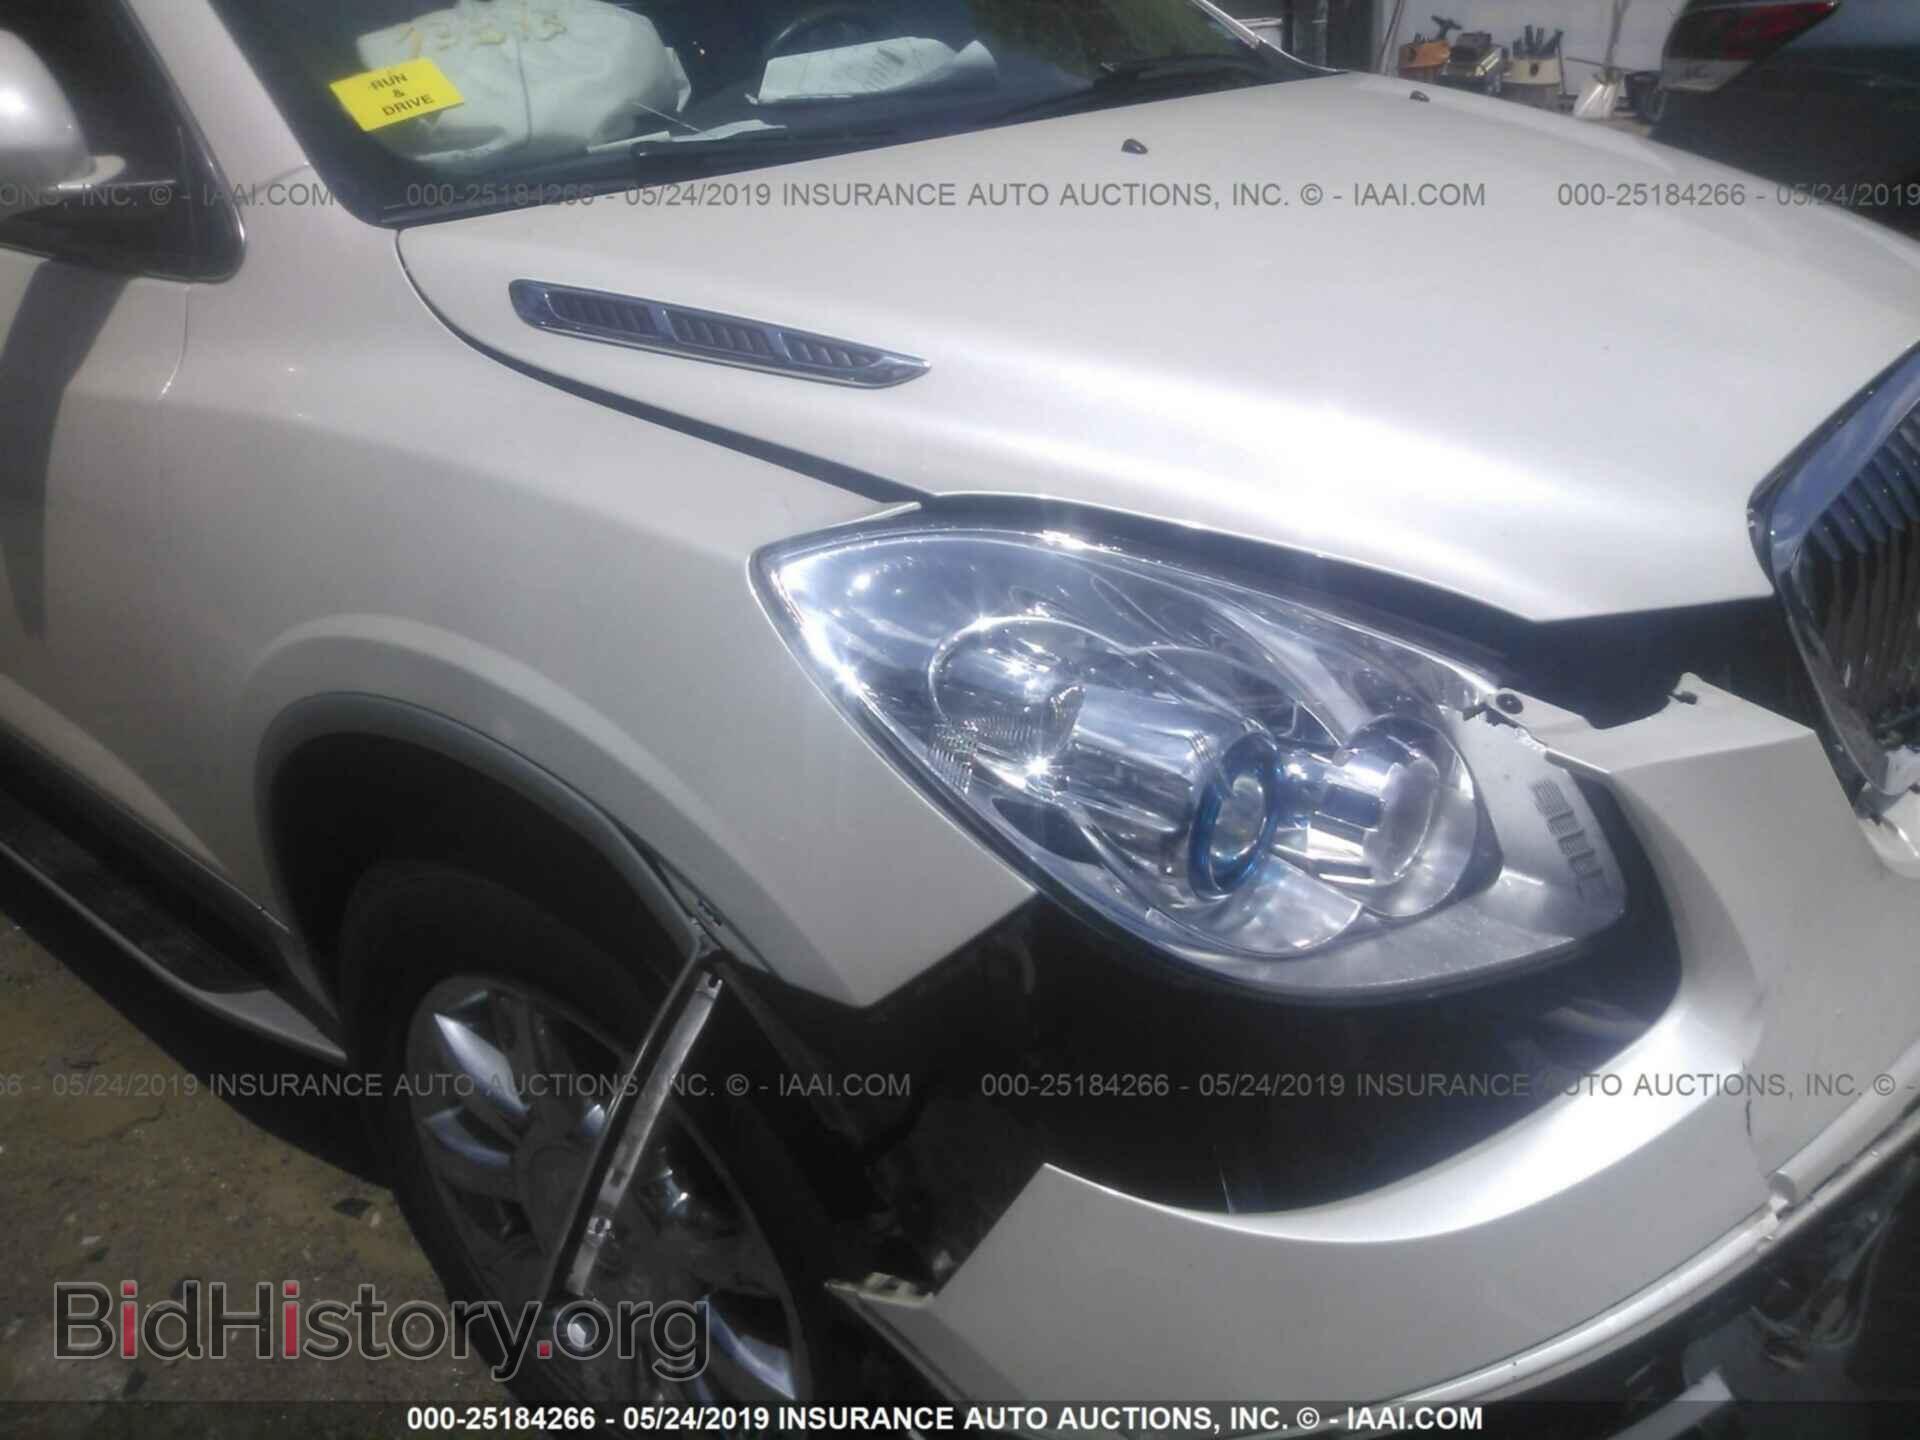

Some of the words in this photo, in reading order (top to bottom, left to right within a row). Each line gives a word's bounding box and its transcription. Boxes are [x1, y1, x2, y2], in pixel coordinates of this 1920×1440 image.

[369, 73, 408, 92] RUN
[391, 88, 406, 98] &
[382, 94, 435, 117] DRIVE
